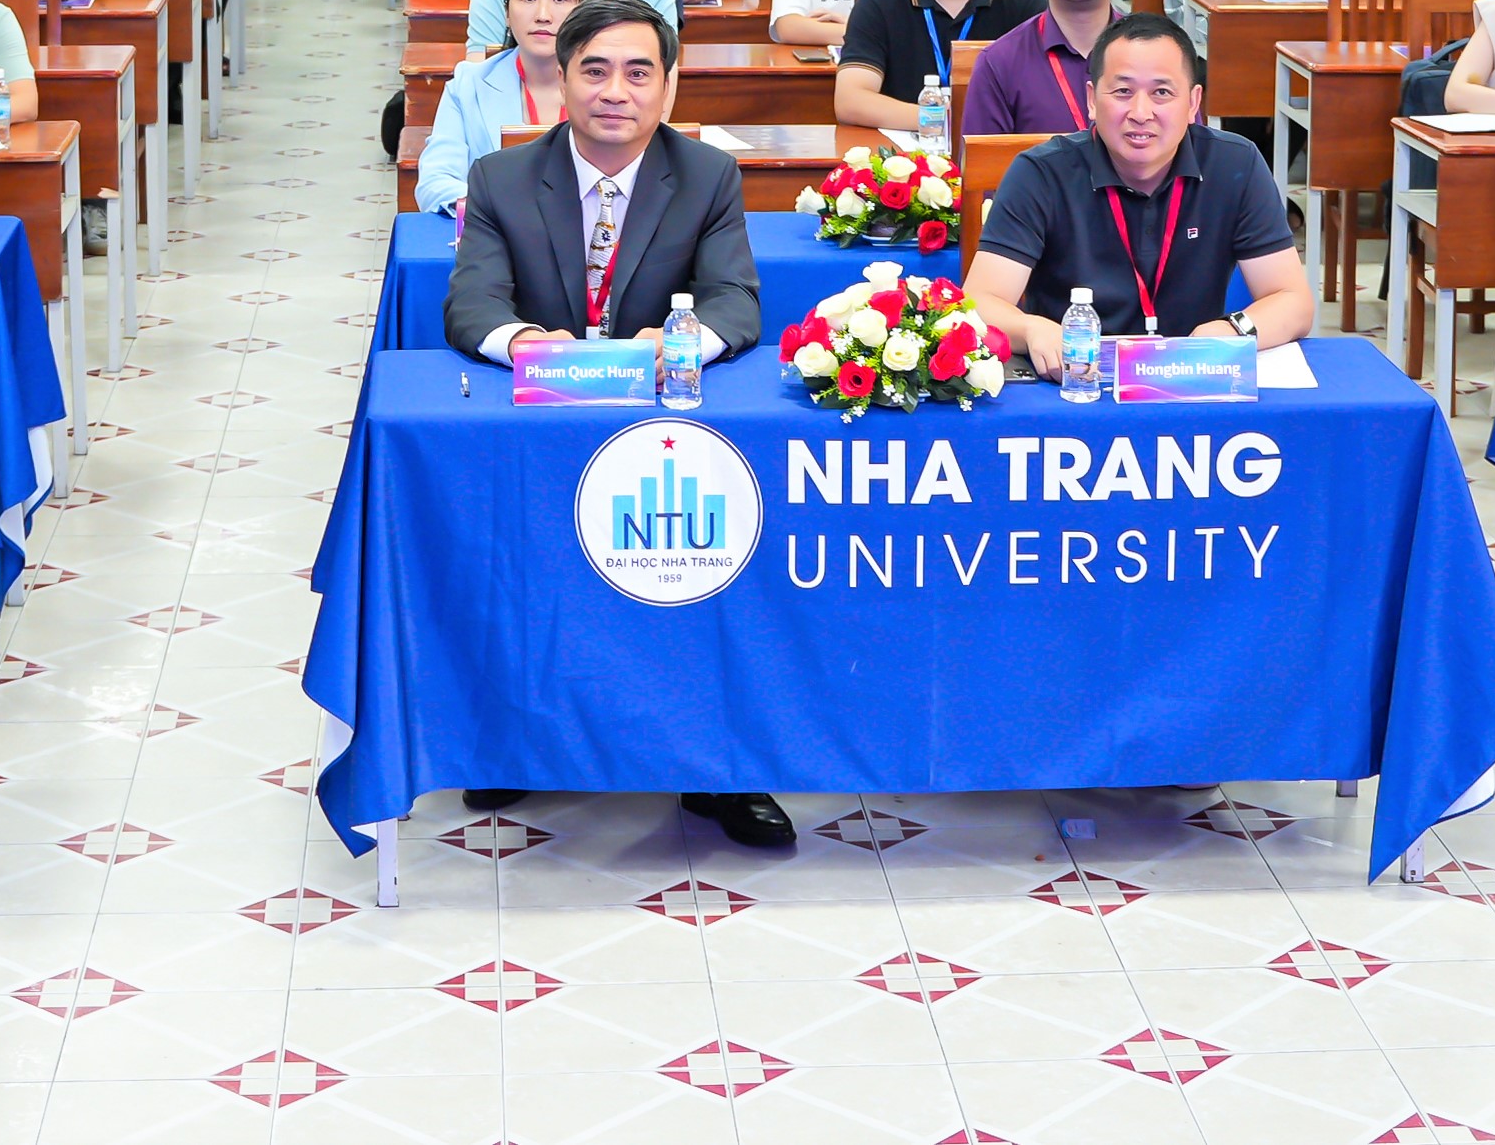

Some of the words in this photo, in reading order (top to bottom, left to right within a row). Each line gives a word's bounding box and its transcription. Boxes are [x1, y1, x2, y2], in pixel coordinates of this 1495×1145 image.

[525, 365, 566, 379] Pham
[568, 365, 605, 381] Quoc
[607, 365, 645, 381] Hung
[1135, 360, 1194, 378] Hongbin
[1196, 361, 1242, 378] Huang
[788, 440, 972, 504] NHA
[998, 432, 1281, 500] TRANG
[623, 512, 715, 551] NTU
[606, 557, 627, 570] ĐẠI
[631, 557, 658, 571] HỌC
[661, 557, 687, 567] NHA
[690, 557, 733, 567] TRANG
[789, 526, 1279, 588] UNIVERSITY
[657, 573, 682, 583] 1959
